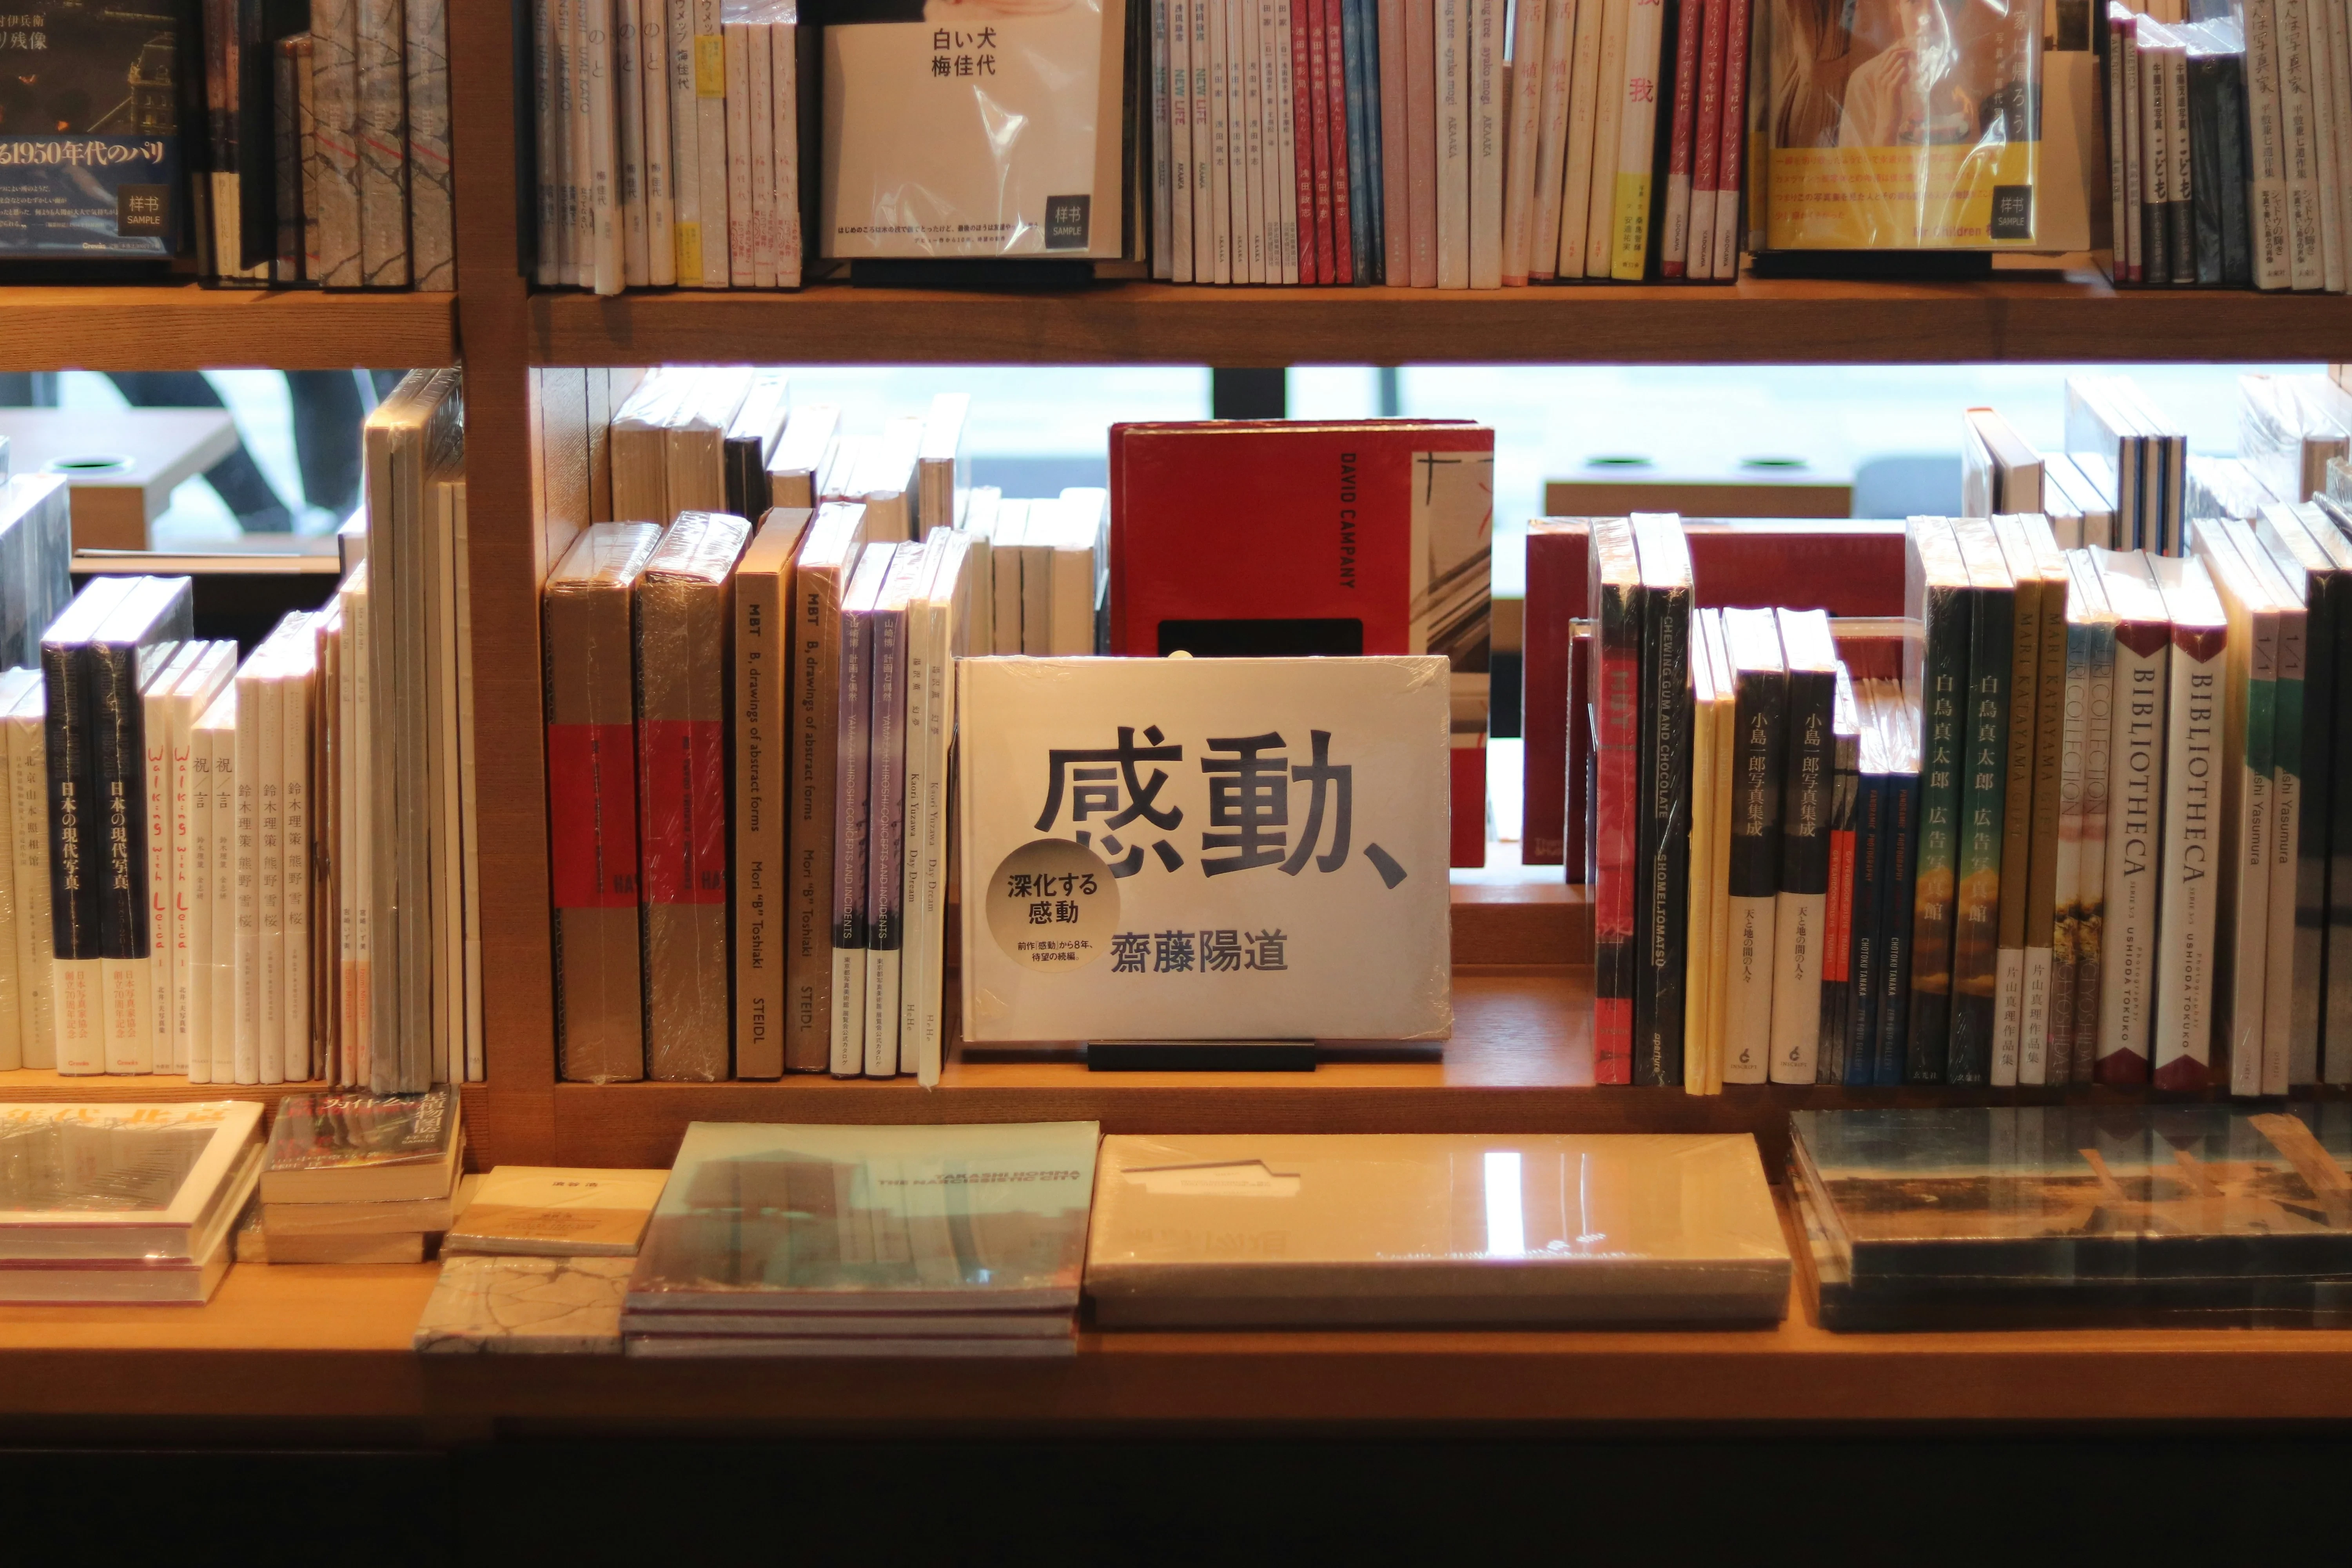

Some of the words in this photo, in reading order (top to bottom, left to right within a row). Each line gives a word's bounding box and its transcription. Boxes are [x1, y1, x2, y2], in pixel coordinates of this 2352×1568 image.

[933, 27, 996, 51] 白い犬
[931, 54, 996, 77] 梅佳代
[1175, 69, 1185, 97] NEW
[1196, 68, 1206, 96] NEW
[2012, 10, 2029, 133] 家に帰ろう
[1176, 100, 1185, 125] LIFE
[1196, 100, 1206, 125] LIFE
[1629, 77, 1654, 103] 我
[1449, 116, 1457, 159] AKAAKA
[1483, 115, 1491, 157] AKAAKA
[129, 195, 159, 212] 样书
[1054, 206, 1081, 223] 样书
[1300, 169, 1311, 217] 浅田政志
[1318, 170, 1329, 218] 浅田政志
[1336, 167, 1347, 216] 浅田政志
[2000, 197, 2024, 213] 样书
[127, 215, 160, 225] SAMPLE
[1053, 226, 1082, 236] SAMPLE
[1998, 217, 2025, 226] SAMPLE
[1340, 452, 1357, 504] DAVID
[1340, 509, 1356, 589] CAMPANY
[749, 604, 761, 637] MBT
[808, 593, 819, 626] MBT
[884, 619, 893, 648] 山崎博
[748, 652, 761, 664] B,
[805, 641, 819, 654] B,
[1662, 617, 1673, 677] CHEWING
[2019, 613, 2034, 663] MARI
[2046, 613, 2061, 664] MARI
[2255, 637, 2273, 671] 1/1
[2284, 634, 2302, 670] 1/1
[746, 668, 761, 723] drawings
[802, 657, 819, 711] drawings
[848, 654, 858, 702] 計画と偶然
[883, 654, 893, 702] 計画と偶然
[1661, 681, 1671, 712] GUM
[751, 727, 762, 740] of
[806, 716, 817, 728] of
[847, 714, 857, 762] YAMAZAKI
[882, 714, 891, 762] YAMAZAKI
[1660, 715, 1671, 741] AND
[1930, 675, 1953, 789] 白鳥真太郎
[1974, 675, 1998, 791] 白鳥真太郎
[2013, 674, 2031, 782] KATAYAMA
[2040, 674, 2059, 781] KATAYAMA
[750, 743, 762, 793] abstract
[804, 731, 817, 781] abstract
[2062, 685, 2085, 816] COLLECTION
[2086, 683, 2111, 815] COLLECTION
[2123, 668, 2155, 878] BIBLIOTHECA
[148, 745, 163, 836] Walking
[174, 745, 191, 836] Walking
[911, 773, 920, 799] Kaori
[930, 782, 939, 806] Kaori
[1658, 744, 1670, 818] CHOCOLATE
[1746, 712, 1768, 837] 小島一郎写真集成
[1799, 713, 1822, 837] 小島一郎写真集成
[2183, 673, 2213, 884] BIBLIOTHECA
[24, 755, 39, 867] 北京山本照相馆
[238, 784, 252, 848] 鈴木理策
[263, 784, 277, 848] 鈴木理策
[288, 782, 301, 845] 鈴木理策
[750, 796, 761, 833] forms
[803, 786, 814, 821] forms
[910, 802, 919, 837] Yuzawa
[1034, 725, 1408, 889] 感動、
[61, 782, 80, 890] 日本の現代写真
[110, 782, 129, 889] 日本の現代写真
[929, 810, 938, 846] Yuzawa
[2250, 801, 2262, 865] Yasumura
[2279, 800, 2292, 864] Yasumura
[152, 846, 162, 881] with
[177, 846, 187, 881] with
[751, 862, 763, 890] Mori
[804, 849, 815, 877] Mori
[844, 863, 853, 884] AND
[879, 863, 888, 884] AND
[909, 849, 918, 869] Day
[928, 858, 937, 878] Day
[1657, 854, 1667, 903] SHOMEI
[1866, 833, 1875, 882] PHOTOGRAPHY
[1896, 833, 1906, 881] PHOTOGRAPHY
[1924, 806, 1948, 921] 広告写真館
[1968, 808, 1992, 923] 広告写真館
[238, 856, 252, 927] 熊野雪桜
[264, 856, 278, 927] 熊野雪桜
[288, 854, 302, 925] 熊野雪桜
[909, 871, 918, 902] Dream
[927, 881, 937, 912] Dream
[1007, 873, 1098, 897] 深化する
[153, 891, 166, 949] Leica
[176, 891, 189, 949] Leica
[801, 908, 813, 958] Toshiaki
[843, 886, 853, 939] INCIDENTS
[878, 886, 887, 939] INCIDENTS
[1028, 901, 1079, 925] 感動
[1655, 905, 1666, 967] TOMATSU
[752, 921, 764, 969] Toshiaki
[1017, 940, 1094, 951] 前作『感動』から8年、
[1032, 952, 1080, 962] 待望の続編。
[1110, 929, 1289, 973] 齋藤陽道
[1742, 909, 1755, 983] 天と地の間の人々
[1793, 907, 1808, 981] 天と地の間の人々
[1860, 938, 1869, 968] CHOTOKU
[1889, 937, 1899, 968] CHOTOKU
[2124, 927, 2134, 985] USHIODA
[2183, 933, 2194, 991] USHIODA
[65, 971, 76, 1039] 創立70周年記念
[77, 971, 87, 1038] 日本写真家協会
[113, 971, 125, 1039] 創立70周年記念
[125, 970, 136, 1038] 日本写真家協会
[1858, 970, 1867, 996] TANAKA
[1887, 970, 1897, 996] TANAKA
[2132, 947, 2143, 1022] Photography
[753, 998, 765, 1044] STEIDL
[800, 985, 812, 1032] STEIDL
[2002, 966, 2019, 1066] 片山真理作品集
[2026, 964, 2045, 1063] 片山真理作品集
[2052, 989, 2072, 1067] YOSHIDA
[2075, 988, 2096, 1063] YOSHIDA
[2121, 989, 2131, 1041] TOKUKO
[2181, 996, 2192, 1048] TOKUKO
[913, 1176, 1034, 1185] NARCISSISTIC
